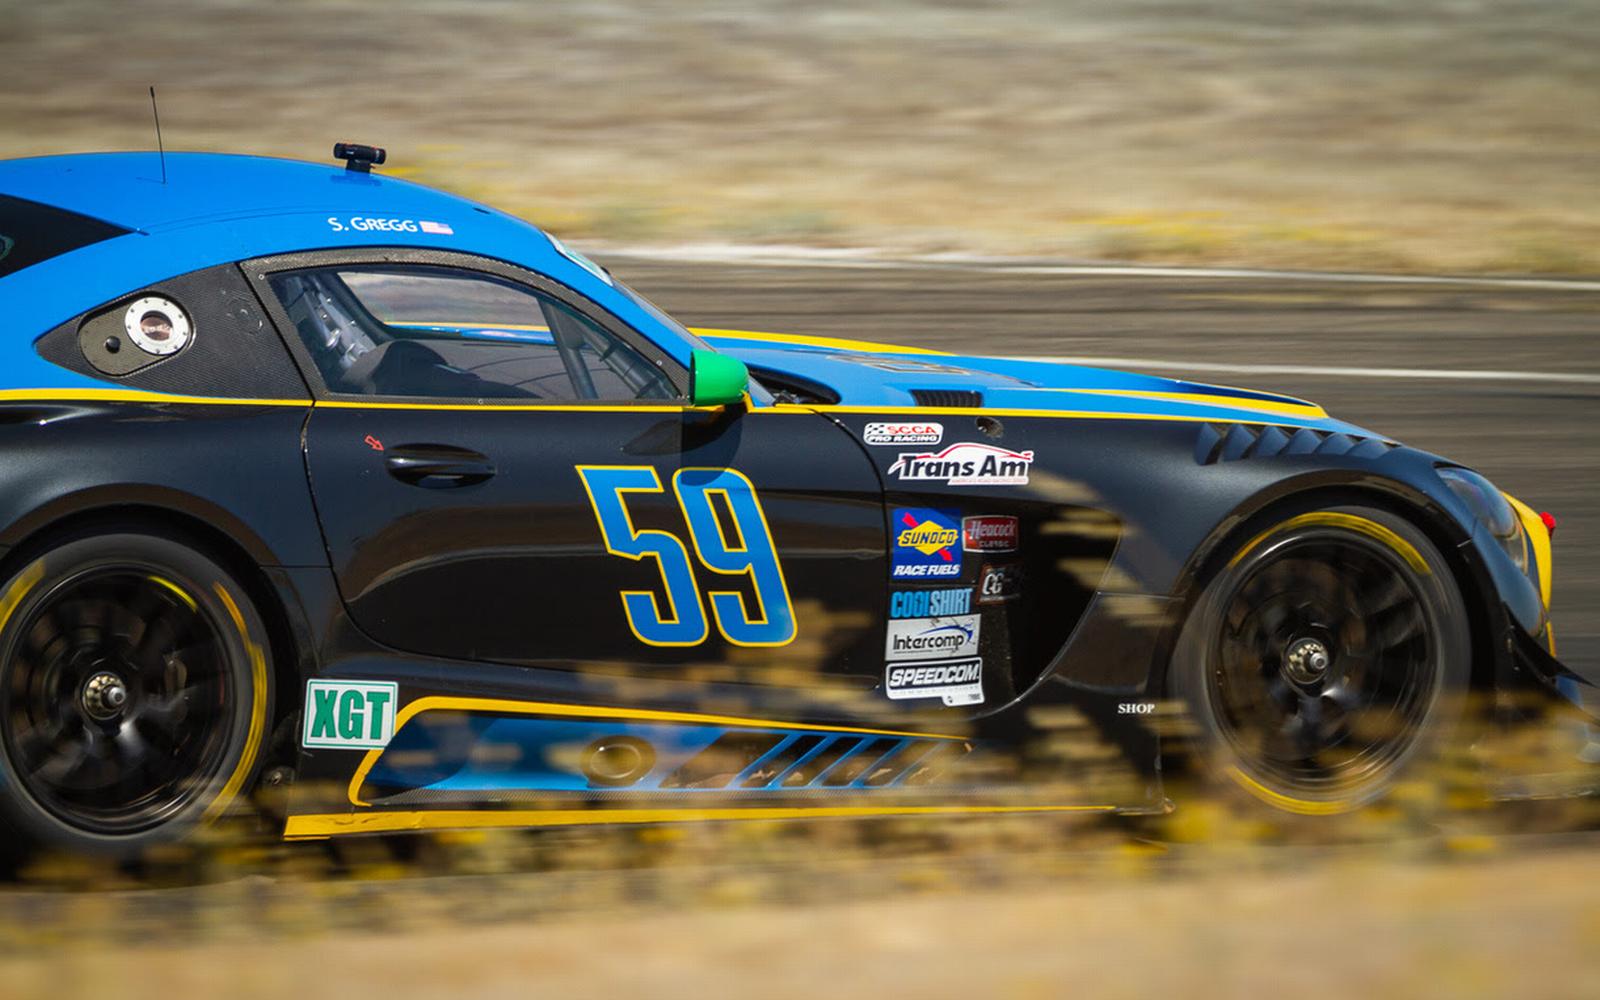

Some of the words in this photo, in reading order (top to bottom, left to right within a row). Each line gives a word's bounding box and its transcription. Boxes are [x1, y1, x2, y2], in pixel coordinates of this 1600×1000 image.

[327, 217, 350, 232] S.
[350, 217, 418, 233] GREGG
[887, 425, 937, 435] SCCA
[901, 455, 974, 477] Trans
[977, 455, 1027, 477] Am
[901, 531, 956, 545] SUNOCO
[574, 465, 798, 647] 59
[893, 565, 927, 576] RACE
[927, 564, 960, 576] FUELS
[893, 634, 964, 651] Intercomp
[311, 689, 390, 740] XGT
[1118, 703, 1155, 714] SHOP
